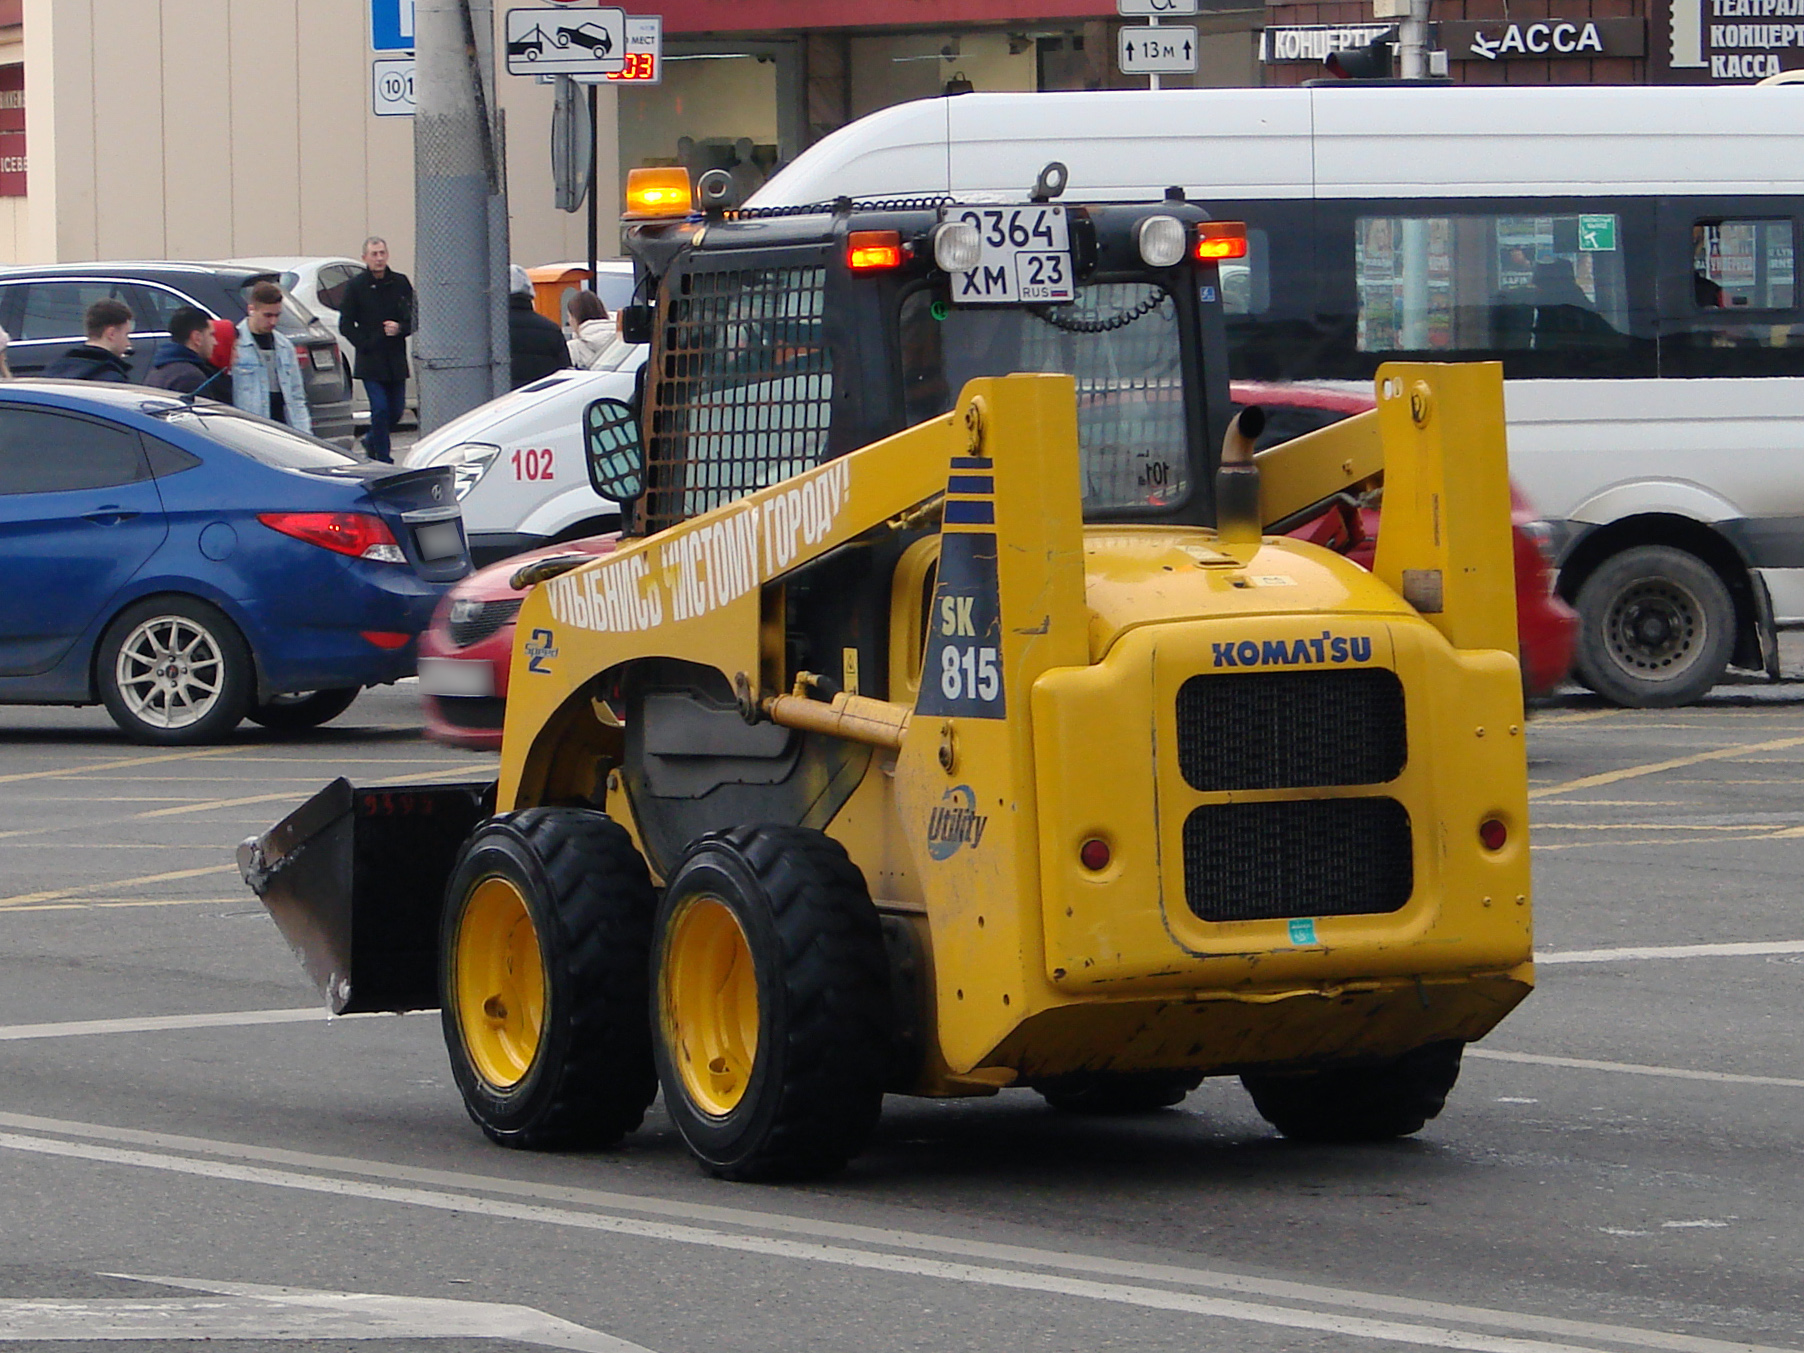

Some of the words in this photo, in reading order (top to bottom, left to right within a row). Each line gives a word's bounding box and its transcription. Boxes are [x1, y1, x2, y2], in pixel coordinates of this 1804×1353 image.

[631, 36, 655, 45] МЕСТ
[1470, 22, 1603, 60] КАССА
[607, 53, 653, 79] 03
[1710, 54, 1781, 78] КАССА
[385, 79, 400, 94] 10
[962, 266, 1008, 295] ХМ
[1028, 255, 1063, 285] 23
[1022, 287, 1050, 298] RUS
[511, 448, 554, 481] 102
[661, 506, 759, 621] ЧИСТОМУ
[763, 458, 850, 576] ГОРОДУ!
[941, 595, 976, 637] SK
[528, 628, 554, 674] 2
[1211, 631, 1371, 667] KOMATSU
[941, 644, 999, 701] 815
[928, 807, 988, 849] Utility
